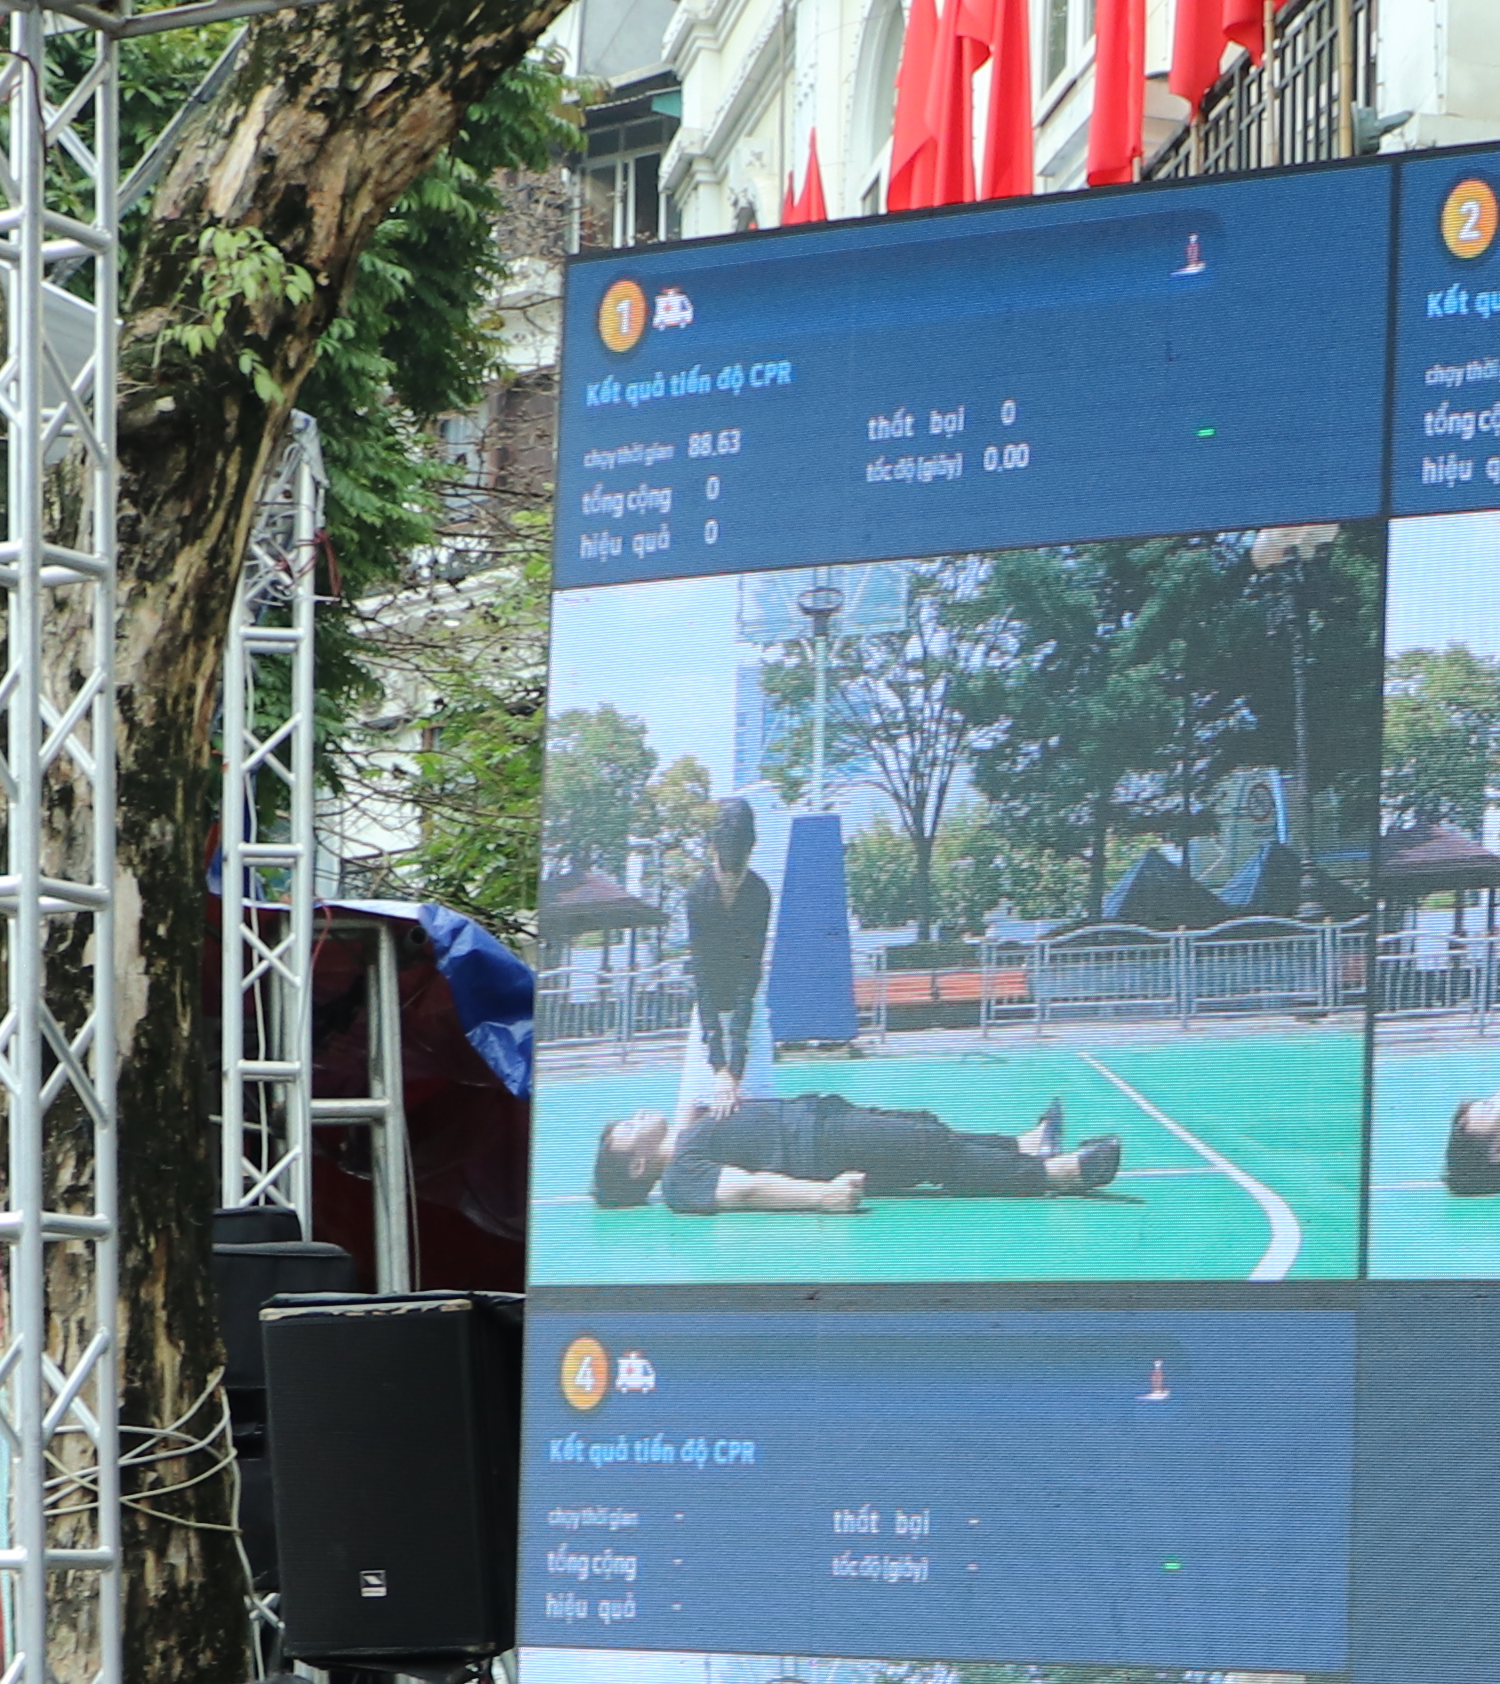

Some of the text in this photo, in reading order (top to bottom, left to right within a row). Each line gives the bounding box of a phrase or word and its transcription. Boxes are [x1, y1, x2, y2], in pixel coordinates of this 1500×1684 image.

[1457, 200, 1481, 241] 2
[1427, 283, 1469, 317] Kết
[615, 298, 633, 335] 1
[586, 359, 792, 409] Kết quả tiến độ CPR
[1001, 398, 1016, 426] 0
[687, 428, 742, 458] 88.63
[706, 475, 721, 500] 0
[703, 518, 719, 545] 0
[574, 1356, 595, 1392] 4
[713, 1438, 756, 1465] CPR
